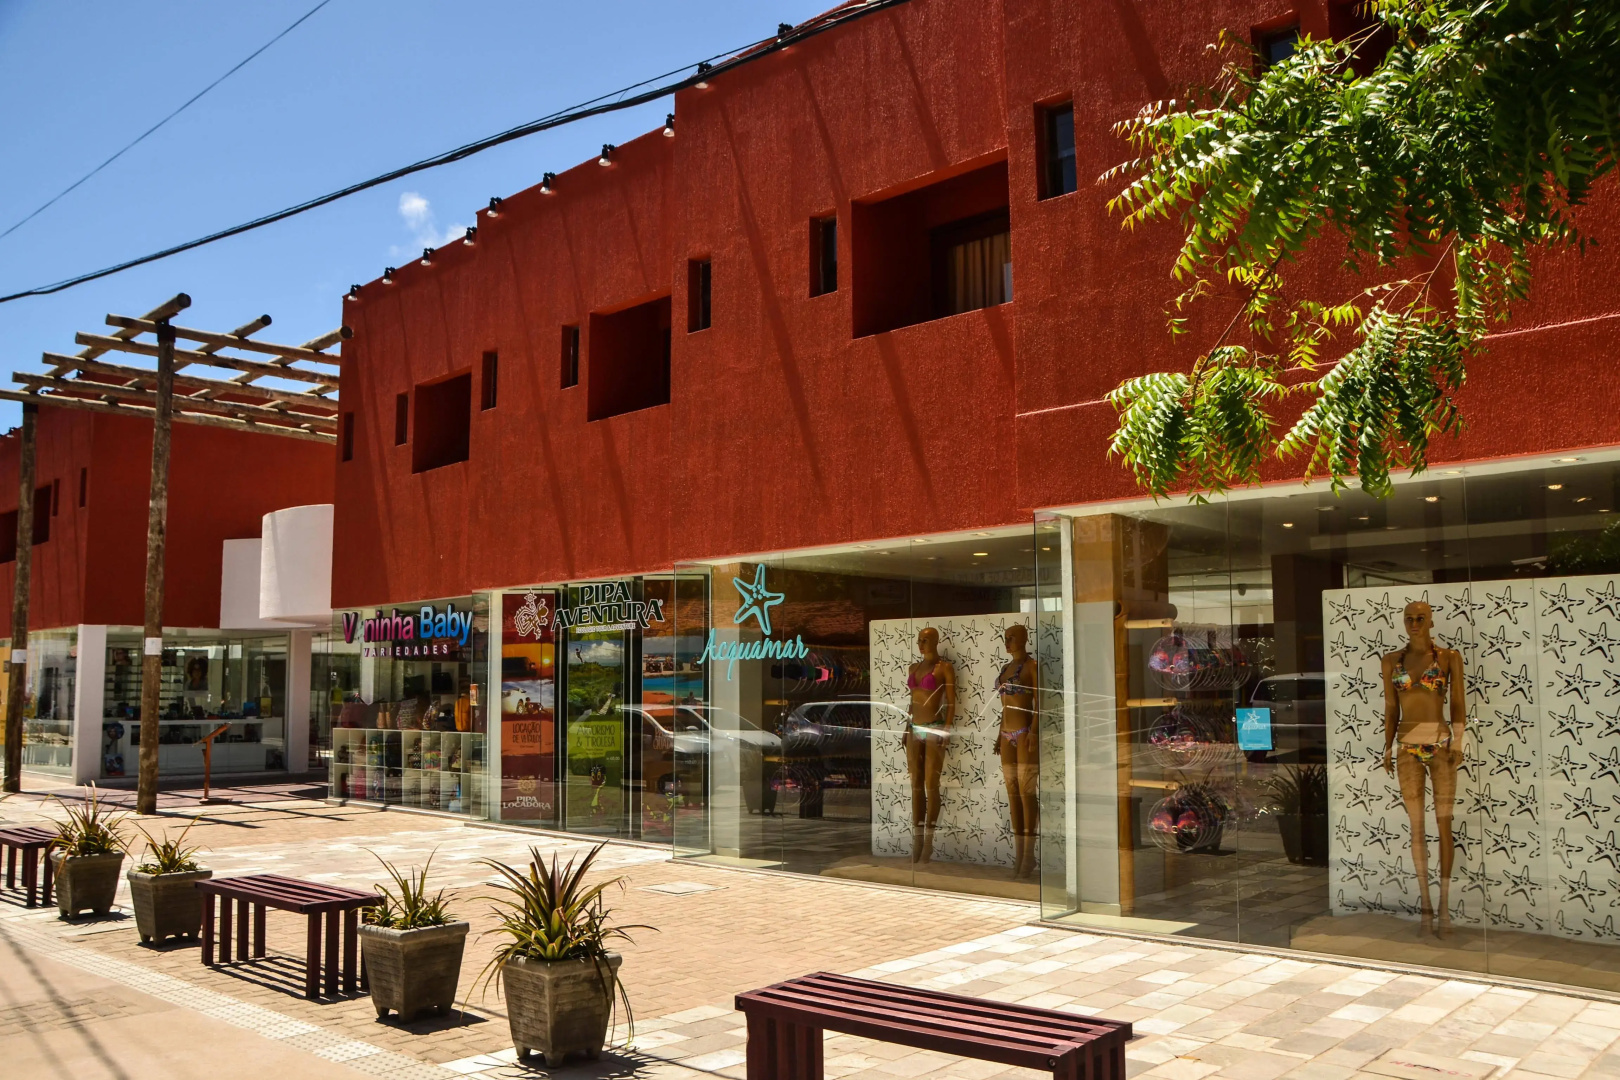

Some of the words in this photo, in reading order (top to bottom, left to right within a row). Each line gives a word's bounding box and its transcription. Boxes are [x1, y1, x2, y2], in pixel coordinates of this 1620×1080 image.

[579, 581, 632, 606] PIPA
[342, 608, 414, 643] Vninha
[420, 603, 472, 646] Baby
[364, 644, 448, 657] VARIEDADES
[697, 628, 809, 681] Acquamar
[512, 721, 541, 734] LOCAÇÃO
[512, 735, 519, 743] DE
[576, 737, 582, 747] &
[585, 736, 615, 747] TIROLESA
[502, 801, 551, 810] LOCADORA
[516, 795, 537, 803] PIPA
